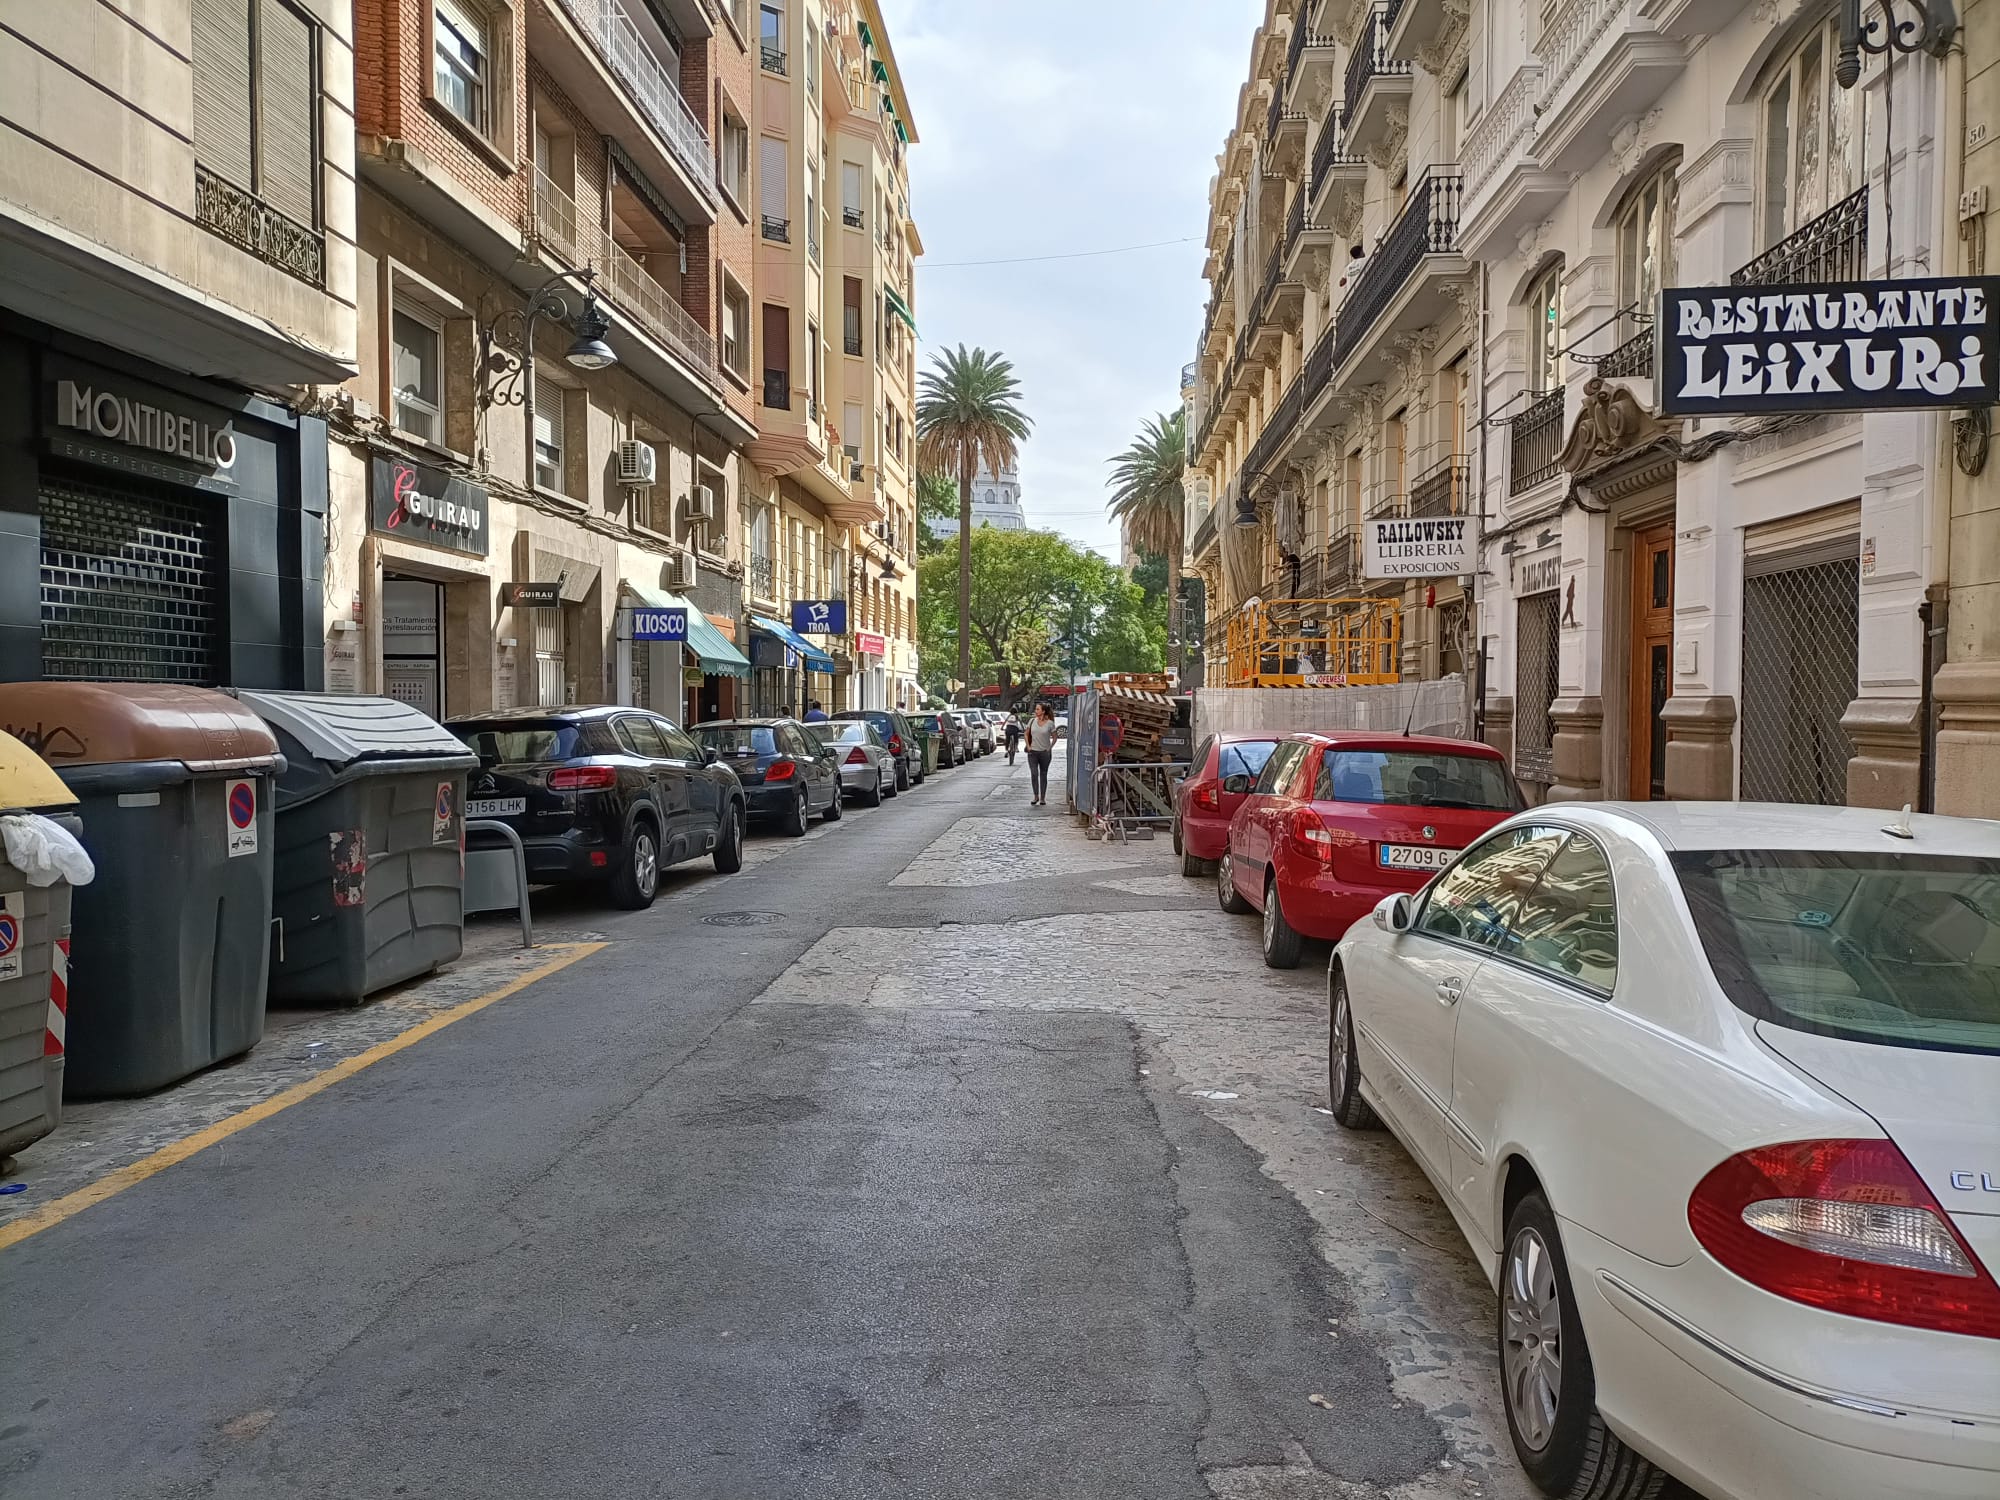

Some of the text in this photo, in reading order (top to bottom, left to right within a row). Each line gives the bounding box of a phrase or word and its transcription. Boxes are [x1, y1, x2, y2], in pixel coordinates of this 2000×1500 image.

[1969, 124, 1985, 144] 50
[1677, 287, 1987, 339] RESTAURANTE
[66, 444, 168, 478] EXPERIENCE
[1377, 520, 1465, 543] RAILOWSKY
[1378, 543, 1465, 558] LLIBRERIA
[1383, 561, 1460, 574] EXPOSICIONS
[635, 614, 685, 633] KIOSCO
[807, 622, 831, 633] TROA
[466, 800, 522, 813] 9156 LHK
[1392, 848, 1433, 865] 2709
[1951, 1170, 2000, 1192] CL
